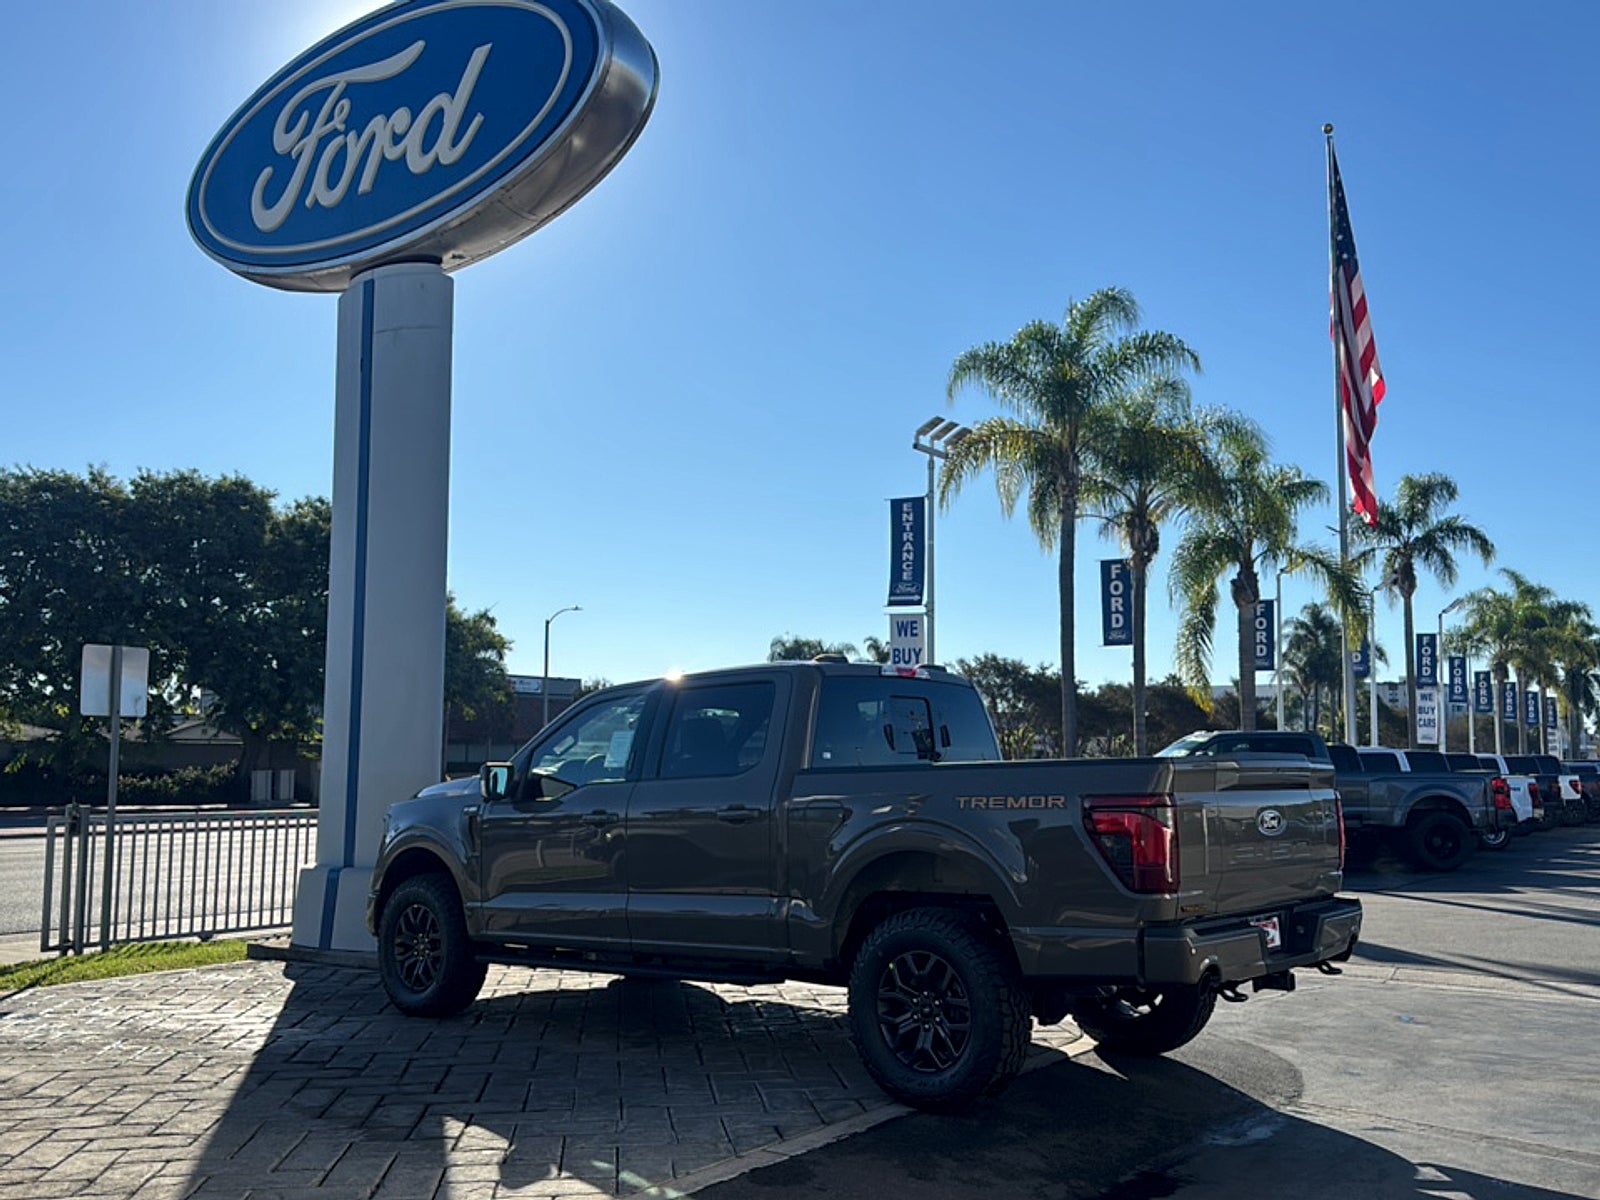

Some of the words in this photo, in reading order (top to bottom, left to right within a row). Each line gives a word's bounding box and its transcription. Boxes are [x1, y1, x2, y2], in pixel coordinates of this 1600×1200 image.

[250, 39, 493, 233] Ford
[902, 502, 914, 580] ENTRANCE
[1109, 564, 1124, 628] FORD
[896, 620, 918, 638] WE
[1255, 603, 1268, 657] FORD
[892, 648, 922, 665] BUY
[1421, 635, 1432, 676] FORD
[1453, 659, 1463, 693] FORD
[1478, 673, 1488, 705] FORD
[1418, 706, 1436, 715] BUY
[955, 795, 1066, 809] TREMOR
